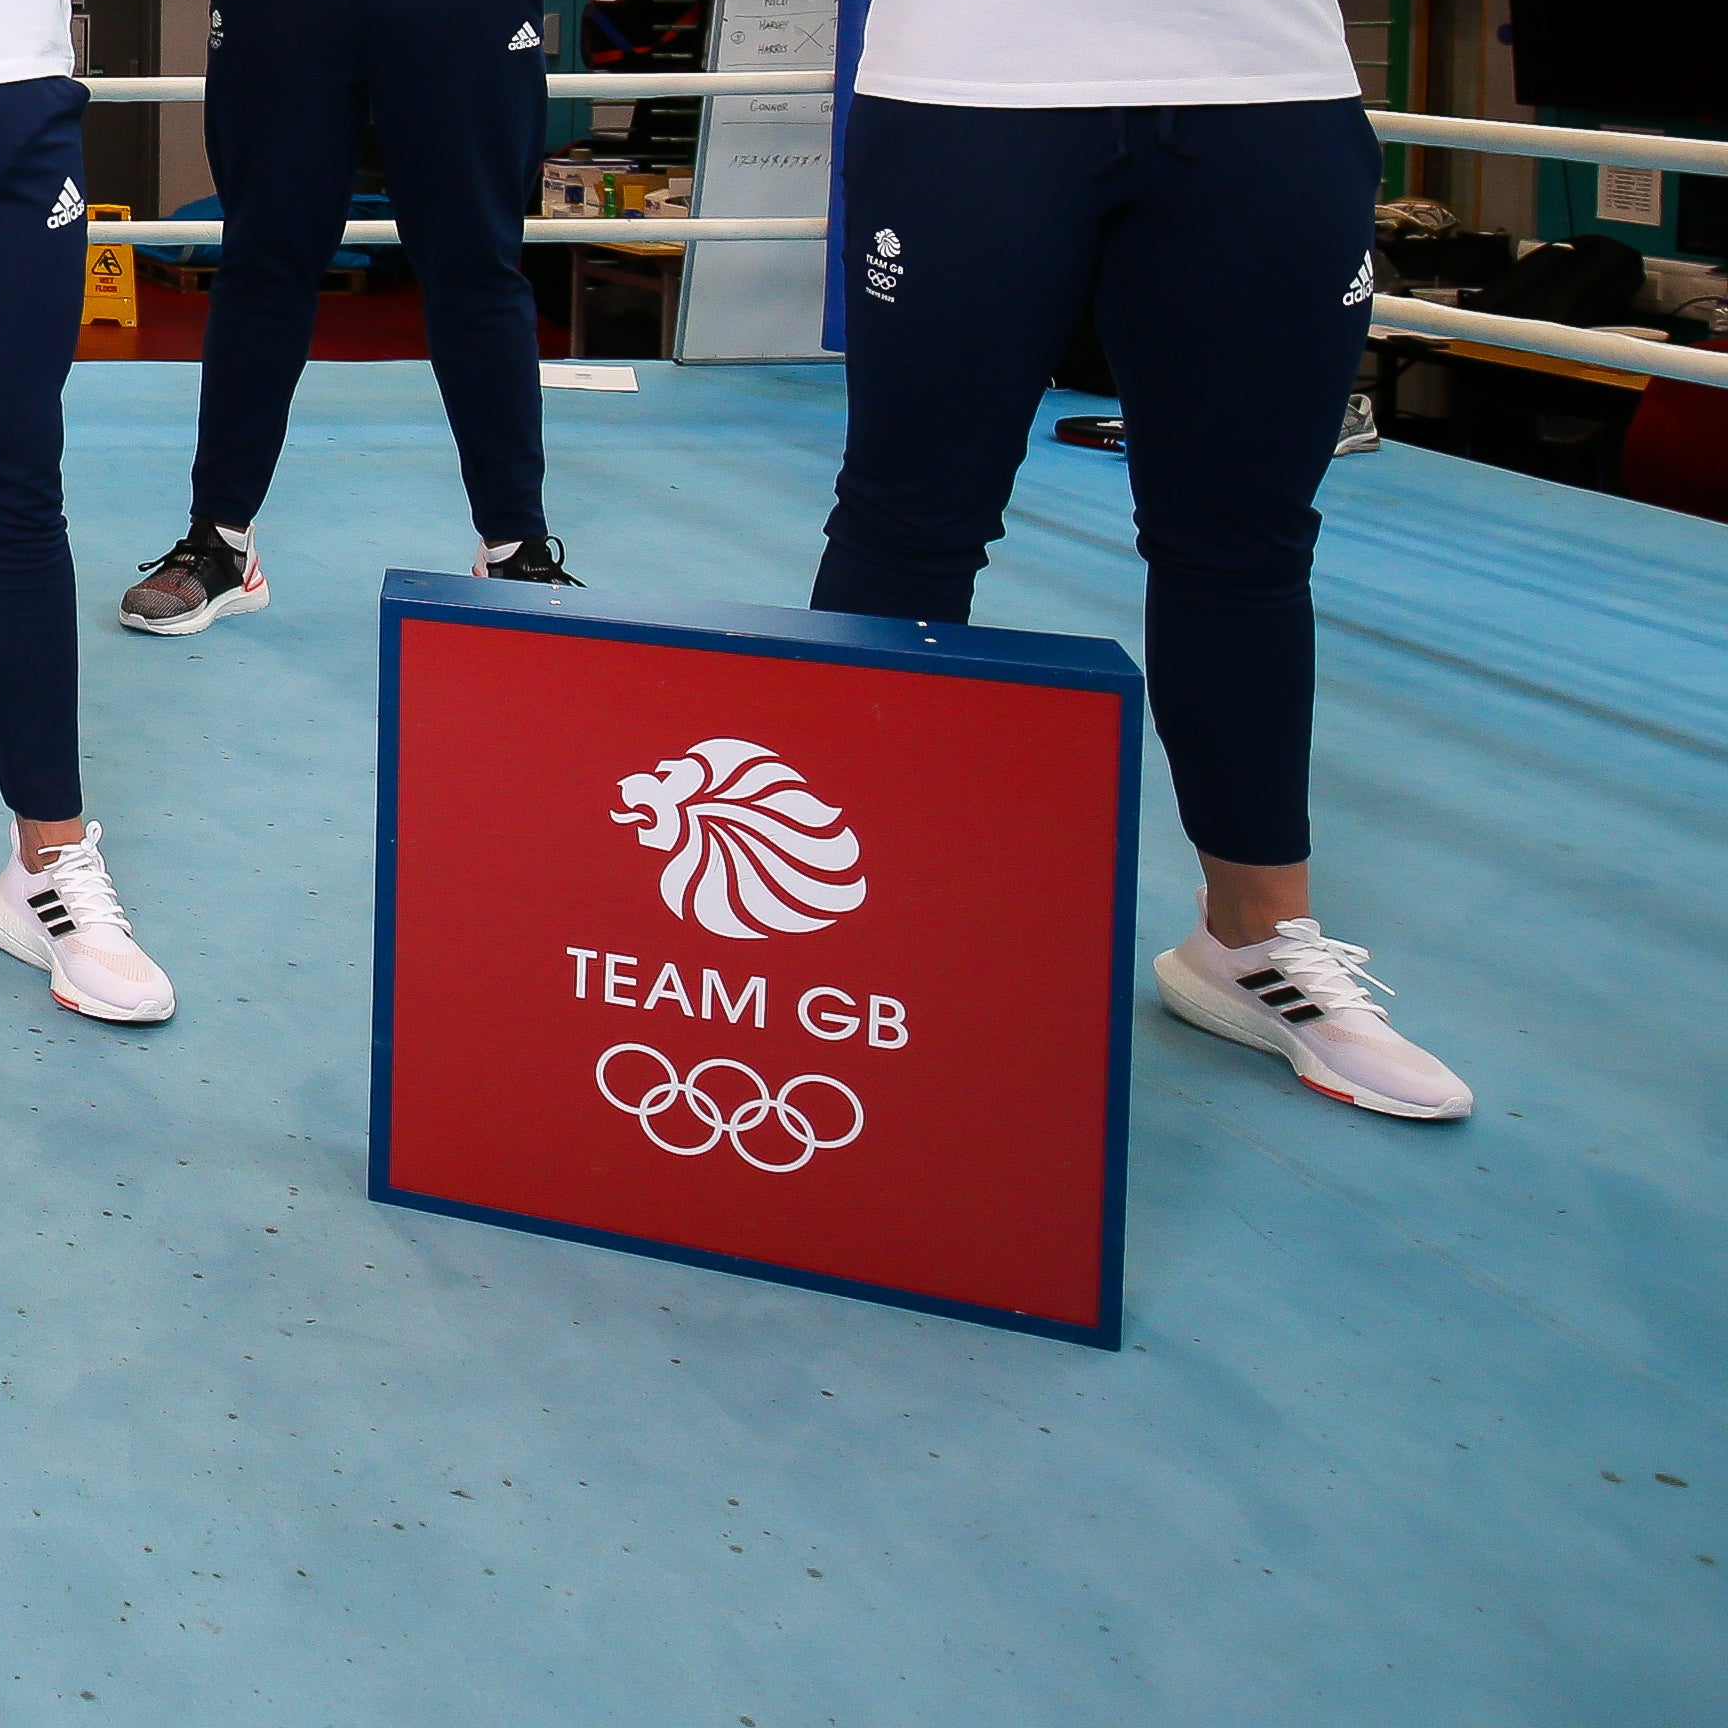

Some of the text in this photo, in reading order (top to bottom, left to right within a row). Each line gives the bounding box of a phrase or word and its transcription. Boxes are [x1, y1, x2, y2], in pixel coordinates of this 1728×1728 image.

[866, 253, 904, 276] TEAM GB
[95, 284, 118, 293] FLOOR
[566, 946, 910, 1050] TEAM GB
